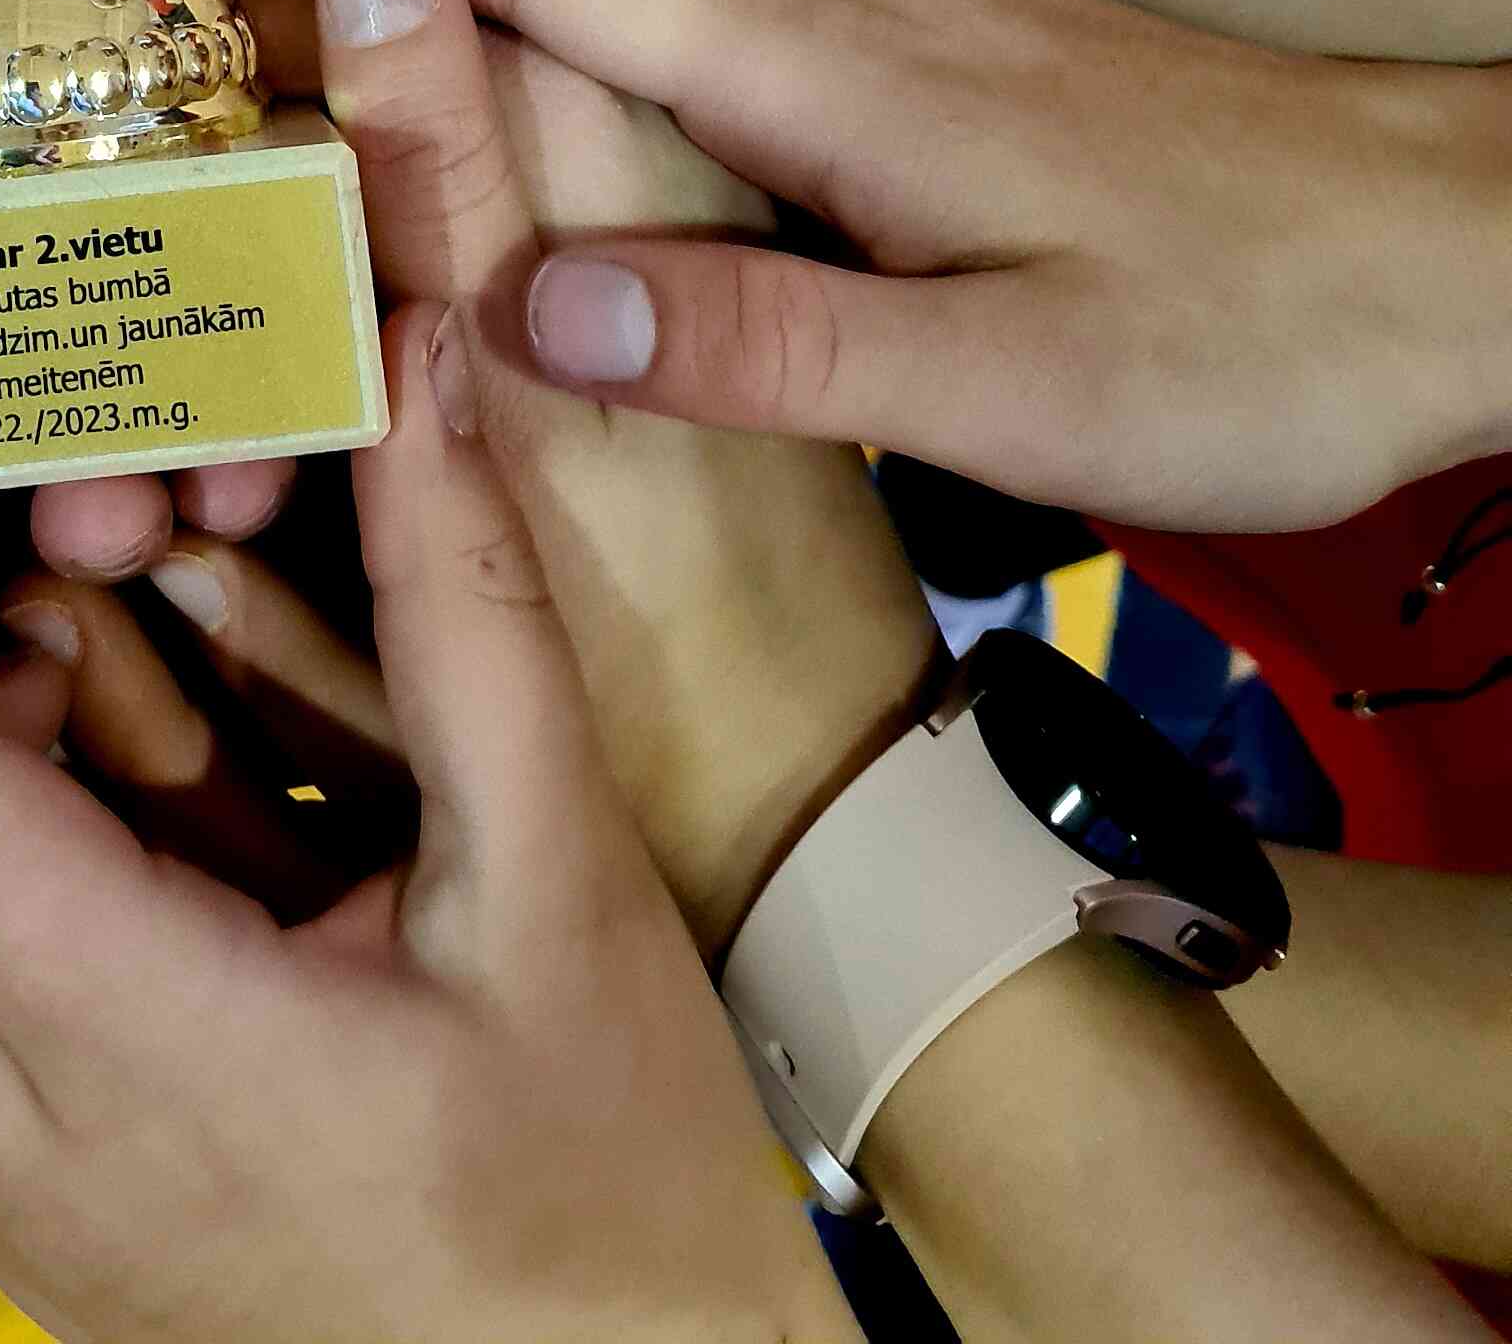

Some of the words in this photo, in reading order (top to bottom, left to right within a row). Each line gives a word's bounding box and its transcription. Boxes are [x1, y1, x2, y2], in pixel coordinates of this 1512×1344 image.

[34, 225, 165, 265] 2.vietu
[67, 267, 172, 305] bumbā
[117, 303, 266, 350] jaunākām
